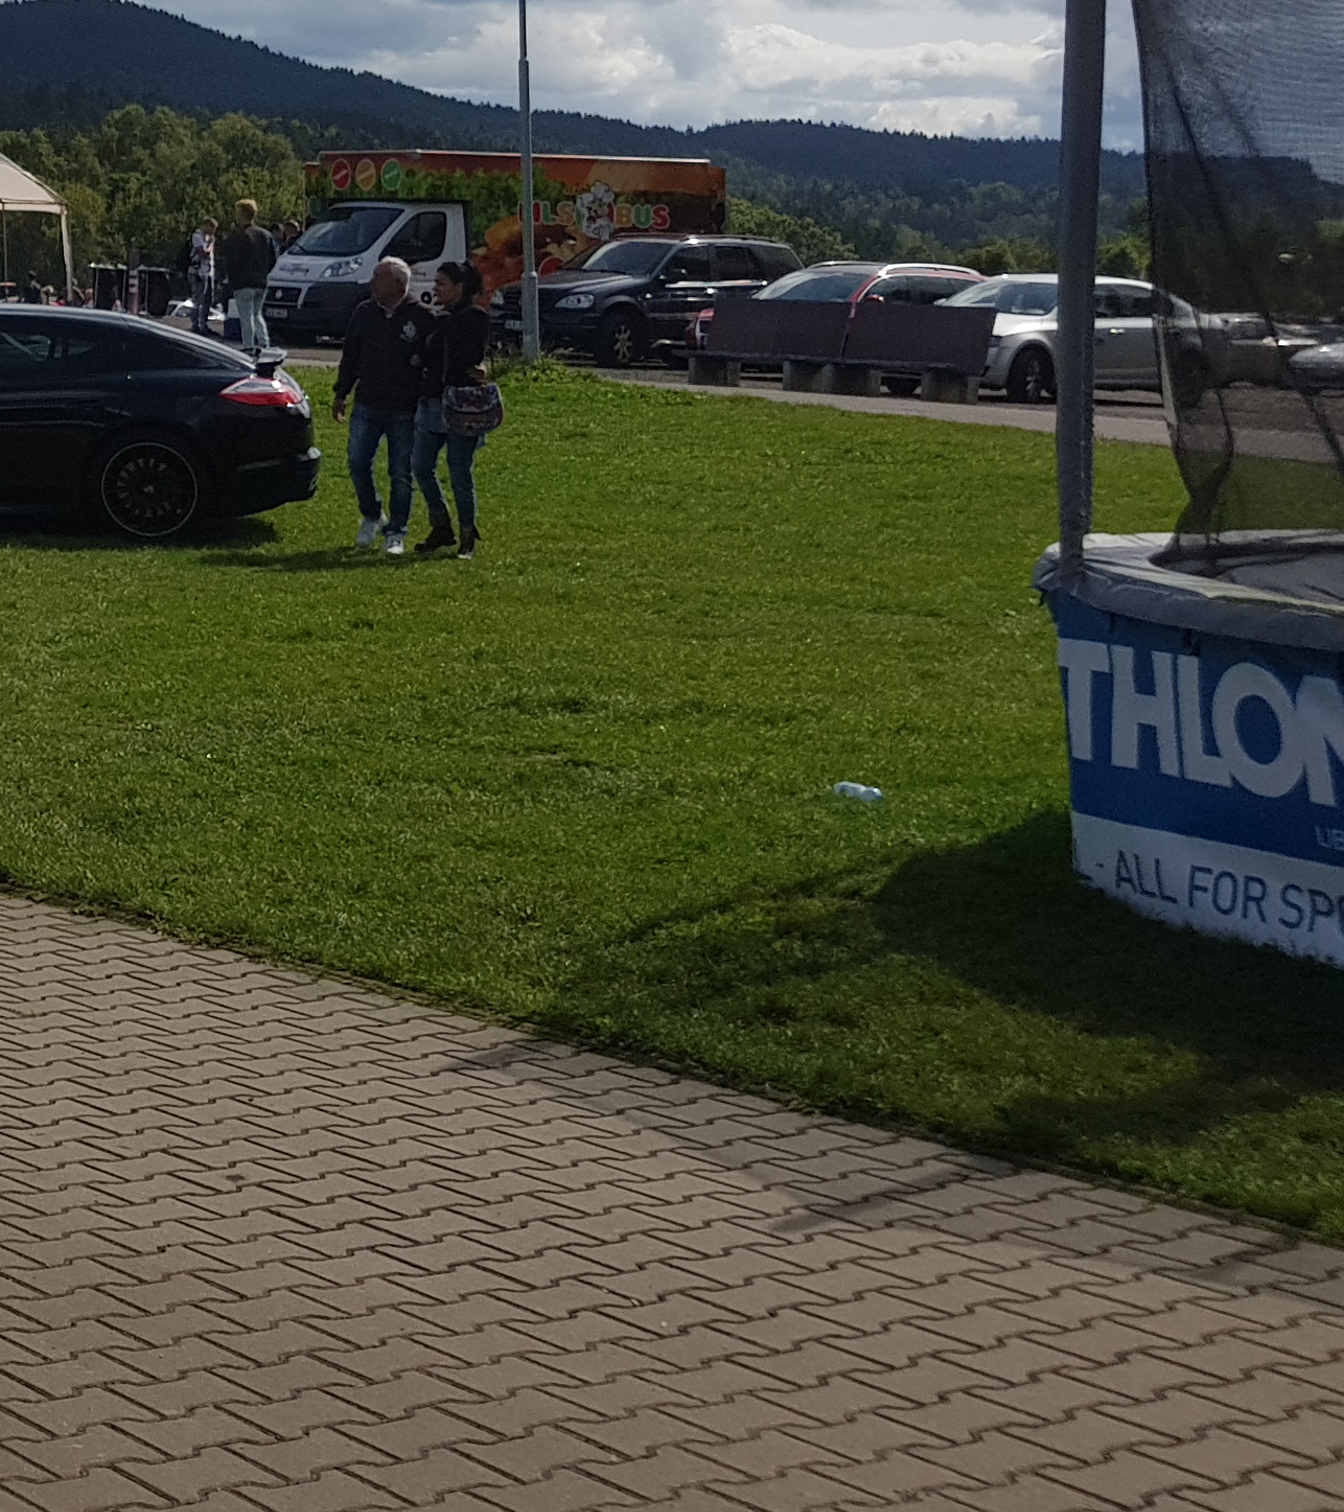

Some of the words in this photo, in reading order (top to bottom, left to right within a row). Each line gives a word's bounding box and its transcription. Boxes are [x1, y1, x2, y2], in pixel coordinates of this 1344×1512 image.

[614, 203, 671, 229] BUS
[1115, 850, 1178, 904] ALL
[1187, 864, 1268, 924] FOR
[1278, 883, 1344, 933] SP
